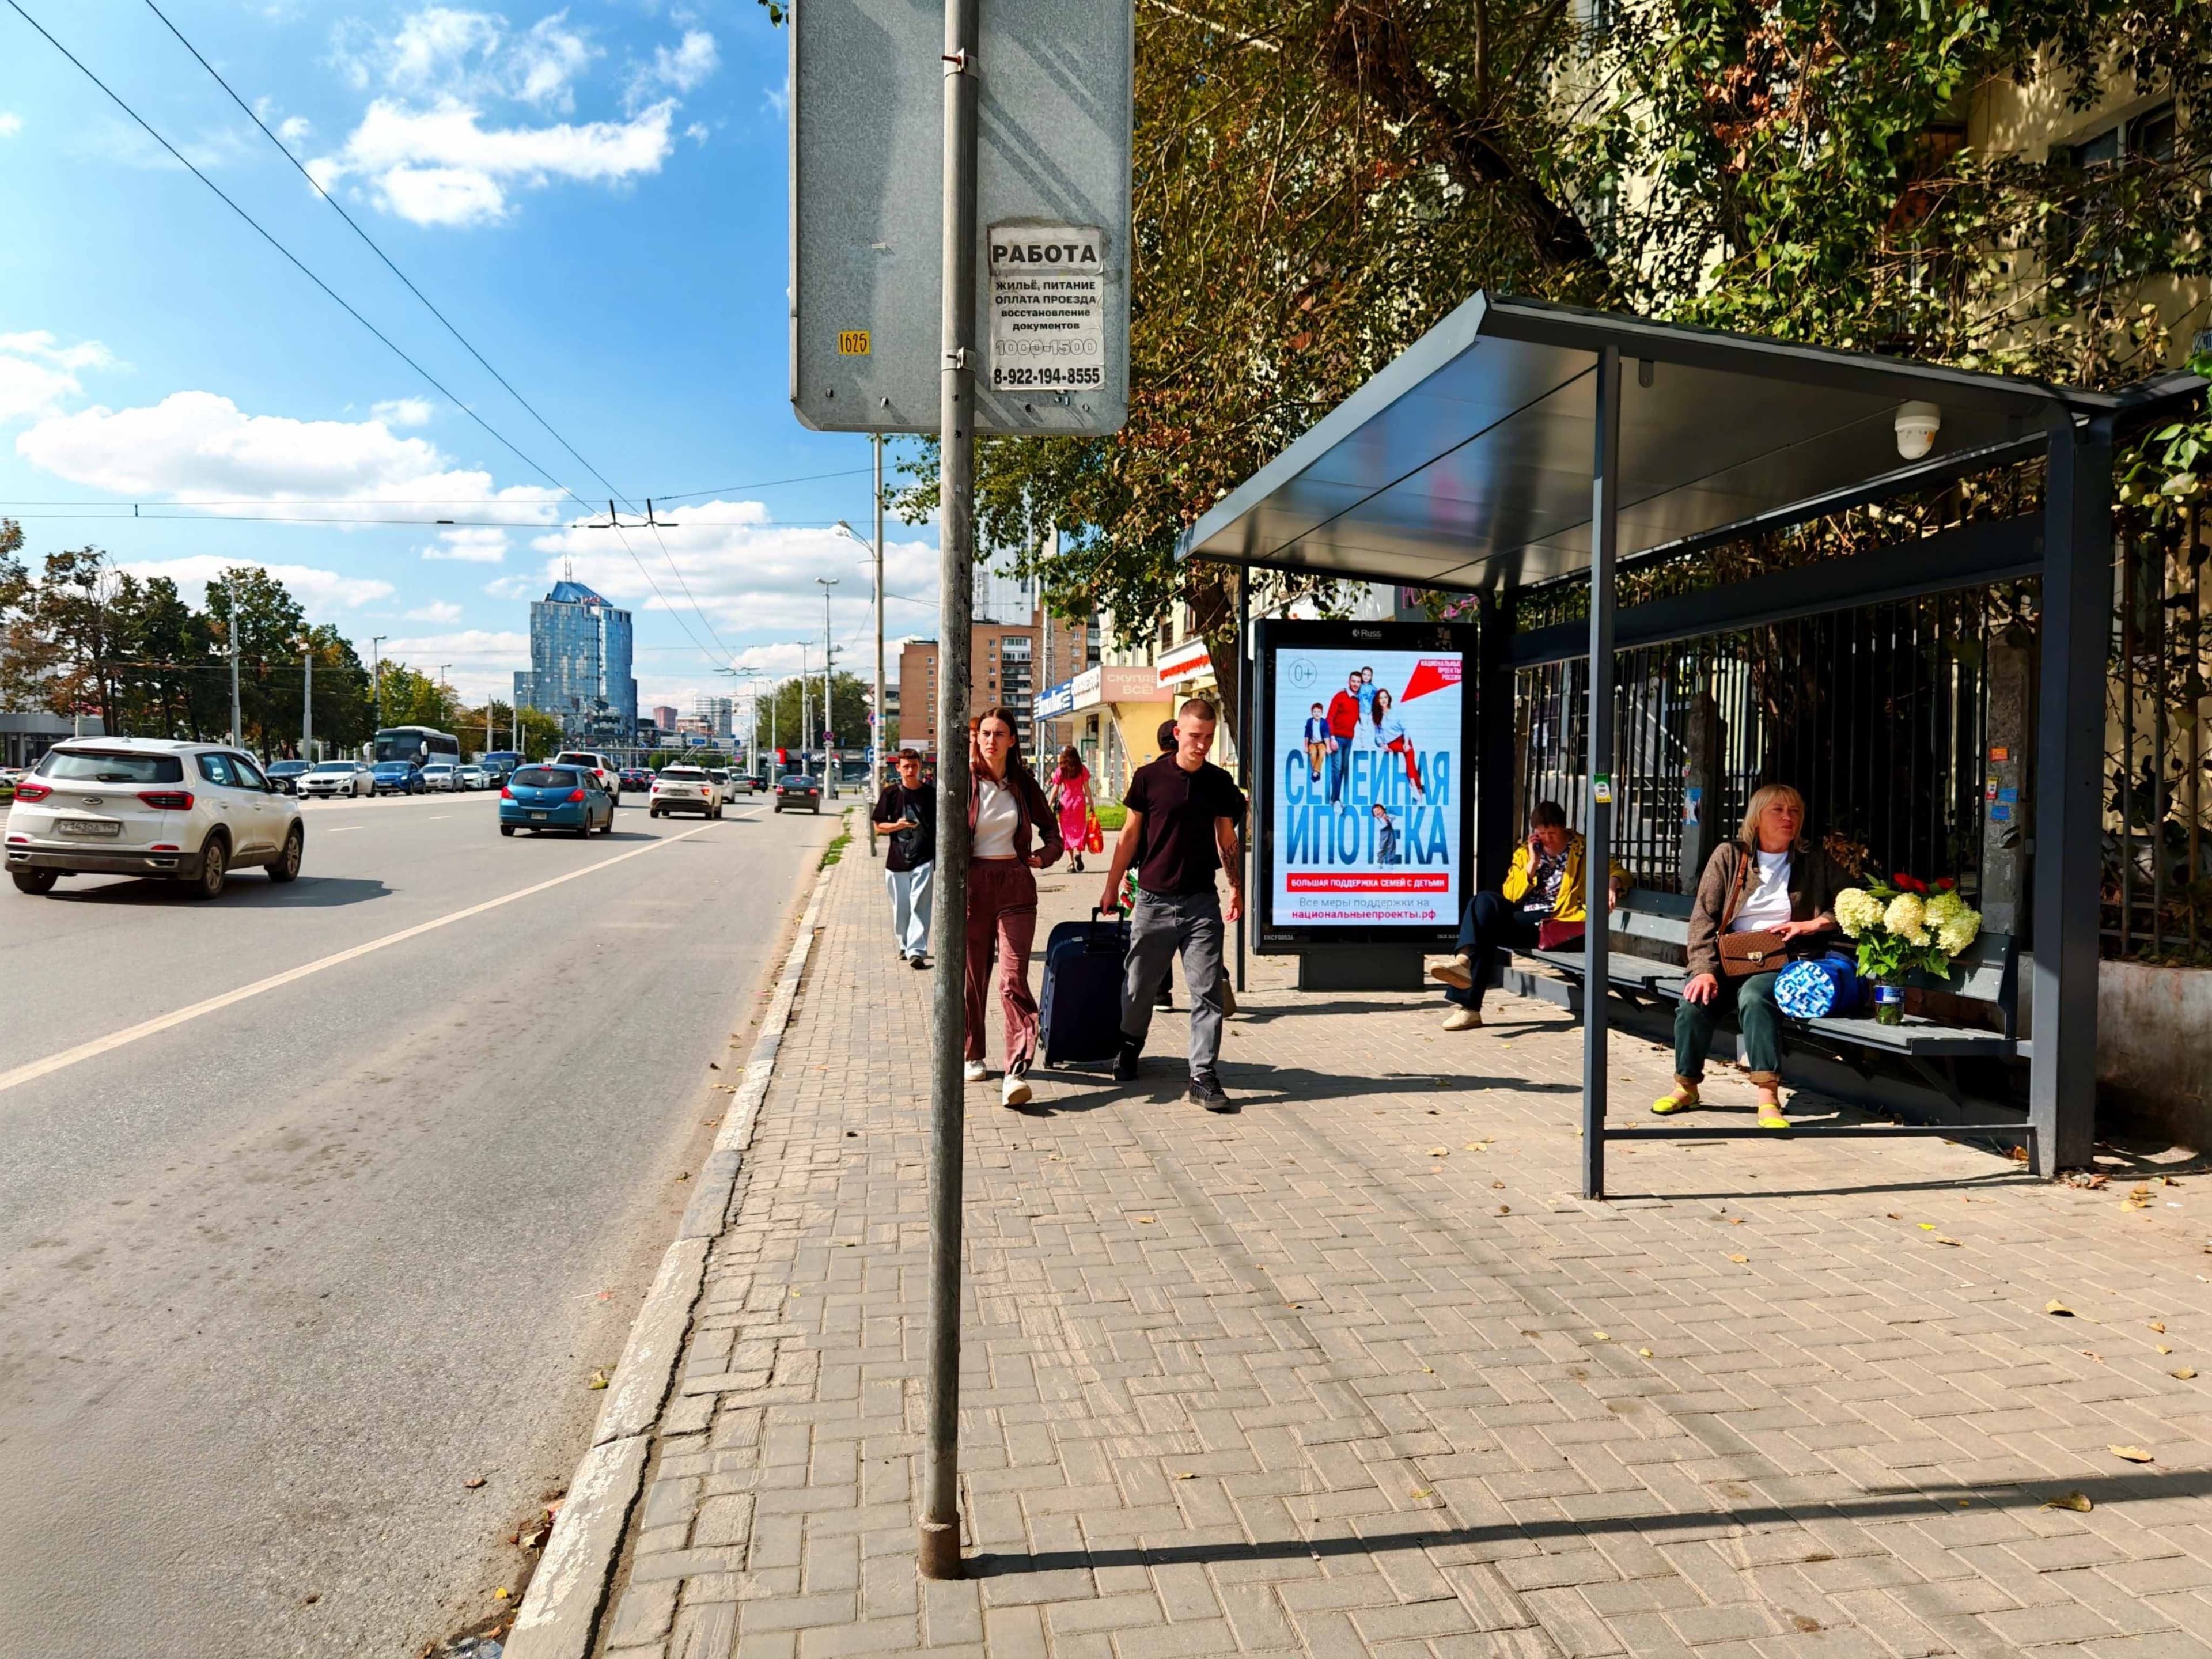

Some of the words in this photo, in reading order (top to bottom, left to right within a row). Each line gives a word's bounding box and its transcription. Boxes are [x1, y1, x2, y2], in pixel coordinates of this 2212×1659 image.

[992, 244, 1097, 263] РАБОТА
[995, 279, 1040, 291] ЖИЛЬЁ,
[1043, 281, 1096, 290] ПИТАНИЕ
[995, 296, 1040, 305] ОПЛАТА
[1043, 295, 1097, 305] ПРОЕЗДА
[1001, 309, 1090, 317] восстановление
[1012, 323, 1080, 332] документов
[840, 333, 867, 353] 1625
[995, 338, 1097, 356] 1000-1500
[994, 367, 1100, 385] 8-922-194-8555
[1361, 629, 1382, 638] Russ
[1107, 674, 1157, 683] СКУПАЕ
[1294, 665, 1313, 681] 0+
[1286, 805, 1450, 865] ИПОТЕКА
[1291, 878, 1328, 887] БОЛЬШАЯ
[1330, 878, 1378, 888] ПОДДЕРЖКА
[1380, 877, 1406, 887] СЕМЕЙ
[1407, 879, 1412, 887] С
[1414, 879, 1445, 888] ДЕТЬМИ
[1299, 897, 1318, 907] Все
[1321, 899, 1351, 910] меры
[1354, 899, 1414, 910] поддержки
[1416, 899, 1430, 907] на
[1291, 909, 1437, 921] национальныепроекты.рф
